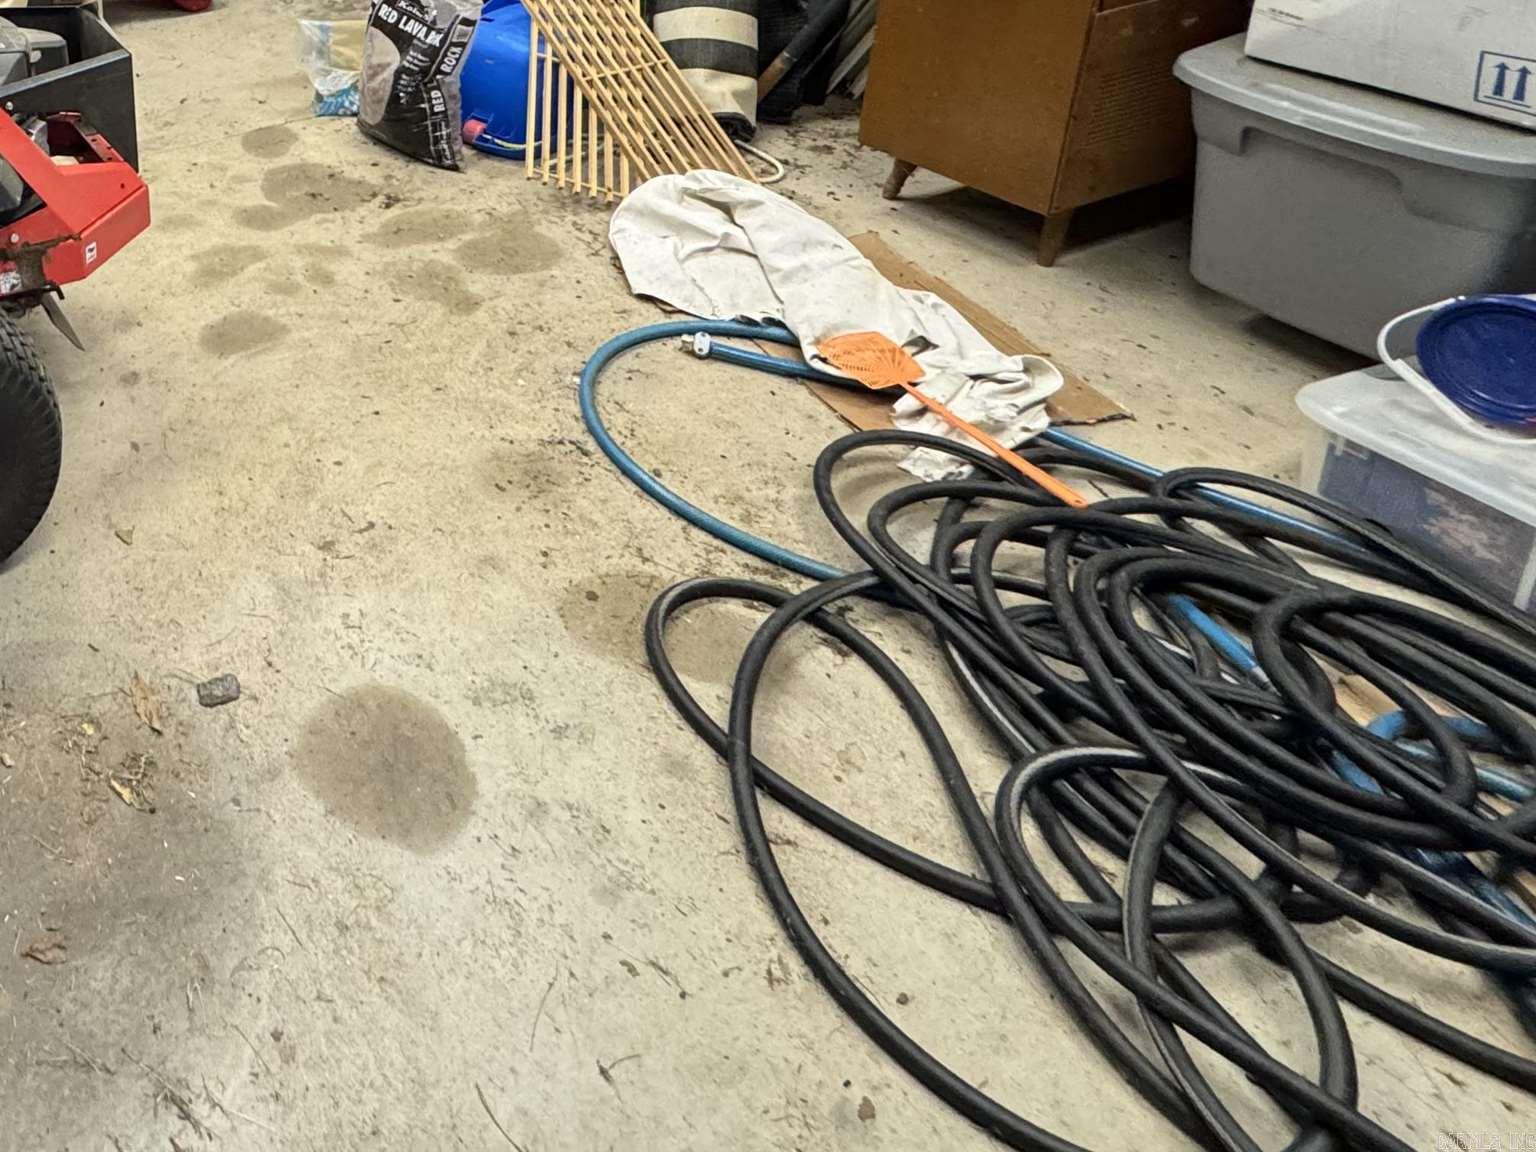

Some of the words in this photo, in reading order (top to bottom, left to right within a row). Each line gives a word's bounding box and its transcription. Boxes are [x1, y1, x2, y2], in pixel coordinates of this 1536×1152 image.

[398, 15, 428, 41] LAVA
[431, 89, 446, 112] RED
[440, 46, 463, 73] ROCK
